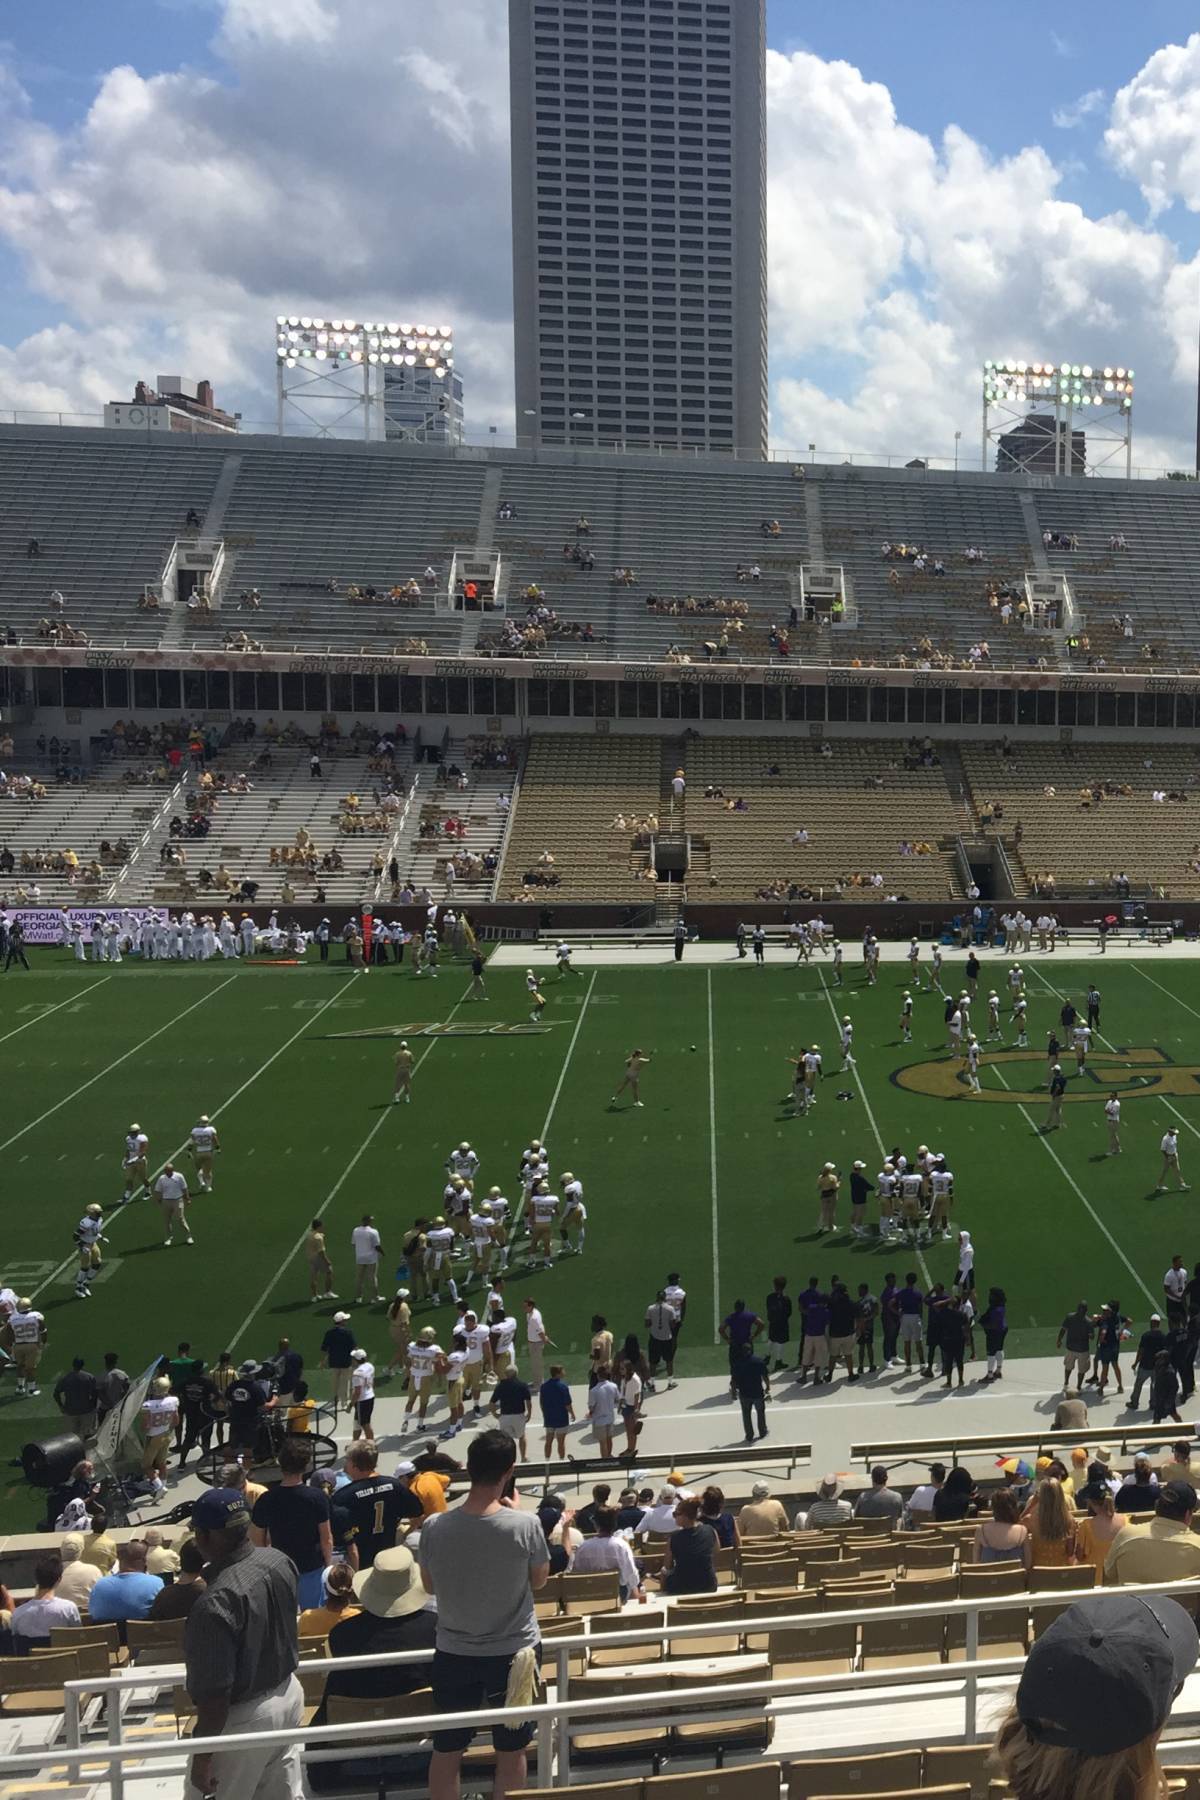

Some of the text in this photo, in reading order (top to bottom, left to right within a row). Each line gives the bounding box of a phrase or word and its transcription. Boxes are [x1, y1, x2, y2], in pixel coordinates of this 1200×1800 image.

[87, 658, 134, 668] SHAW
[289, 662, 409, 674] HALL OF FAME
[533, 670, 587, 679] MORRIS
[624, 671, 664, 680] DAVIS
[372, 1500, 384, 1534] 1
